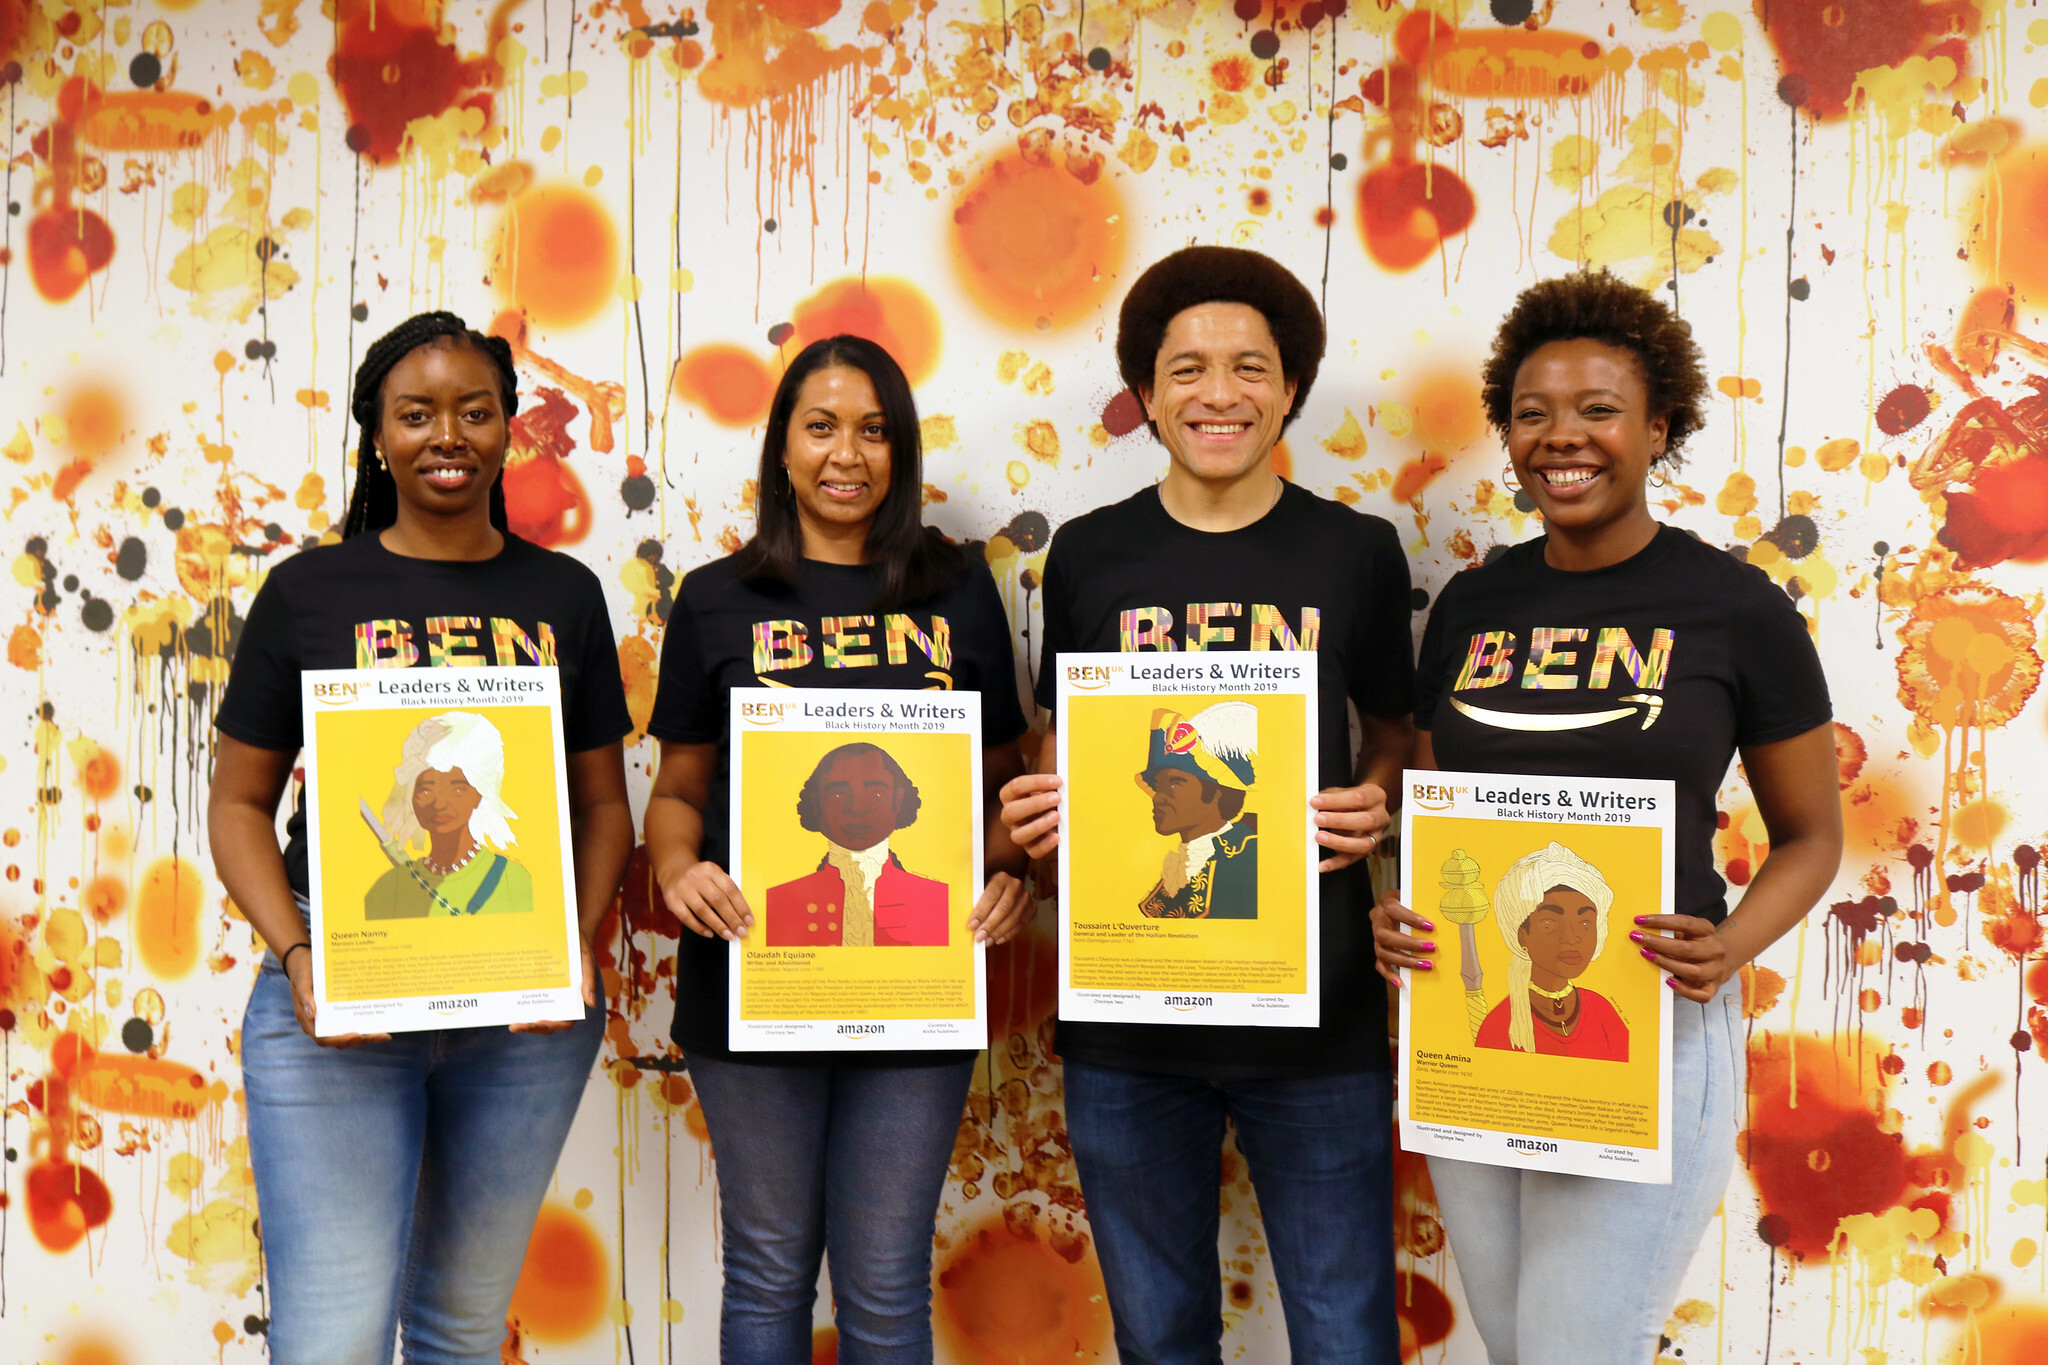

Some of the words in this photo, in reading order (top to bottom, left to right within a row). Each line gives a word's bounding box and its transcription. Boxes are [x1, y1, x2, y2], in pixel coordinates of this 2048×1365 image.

[1119, 602, 1321, 653] BEN
[354, 615, 558, 669] BEN
[752, 613, 953, 674] BEN
[1453, 627, 1675, 691] BEN
[1130, 664, 1203, 679] Leaders
[1209, 663, 1223, 678] &
[1230, 663, 1300, 678] Writers
[378, 679, 450, 693] Leaders
[456, 678, 469, 692] &
[477, 677, 543, 692] Writers
[1152, 683, 1178, 691] Black
[1181, 683, 1216, 691] History
[1253, 682, 1277, 690] 2019
[804, 702, 874, 717] Leaders
[880, 703, 893, 717] &
[900, 703, 965, 718] Writers
[1475, 786, 1550, 805] Leaders
[1557, 790, 1572, 806] &
[1579, 790, 1656, 810] Writers
[1497, 808, 1523, 816] Black
[1527, 809, 1564, 818] History
[1567, 811, 1601, 820] Month
[1604, 812, 1630, 822] 2019
[330, 931, 359, 940] Queen
[360, 930, 388, 938] Nanny
[782, 951, 815, 959] Equiano
[428, 998, 478, 1010] amazon
[1164, 996, 1212, 1006] amazon
[836, 1024, 884, 1033] amazon
[1416, 1049, 1443, 1060] Queen
[1444, 1053, 1471, 1062] Amina
[1438, 1061, 1458, 1069] Queen
[1452, 1129, 1475, 1138] designed
[1506, 1137, 1557, 1152] amazon
[1614, 1155, 1639, 1163] Suleiman
